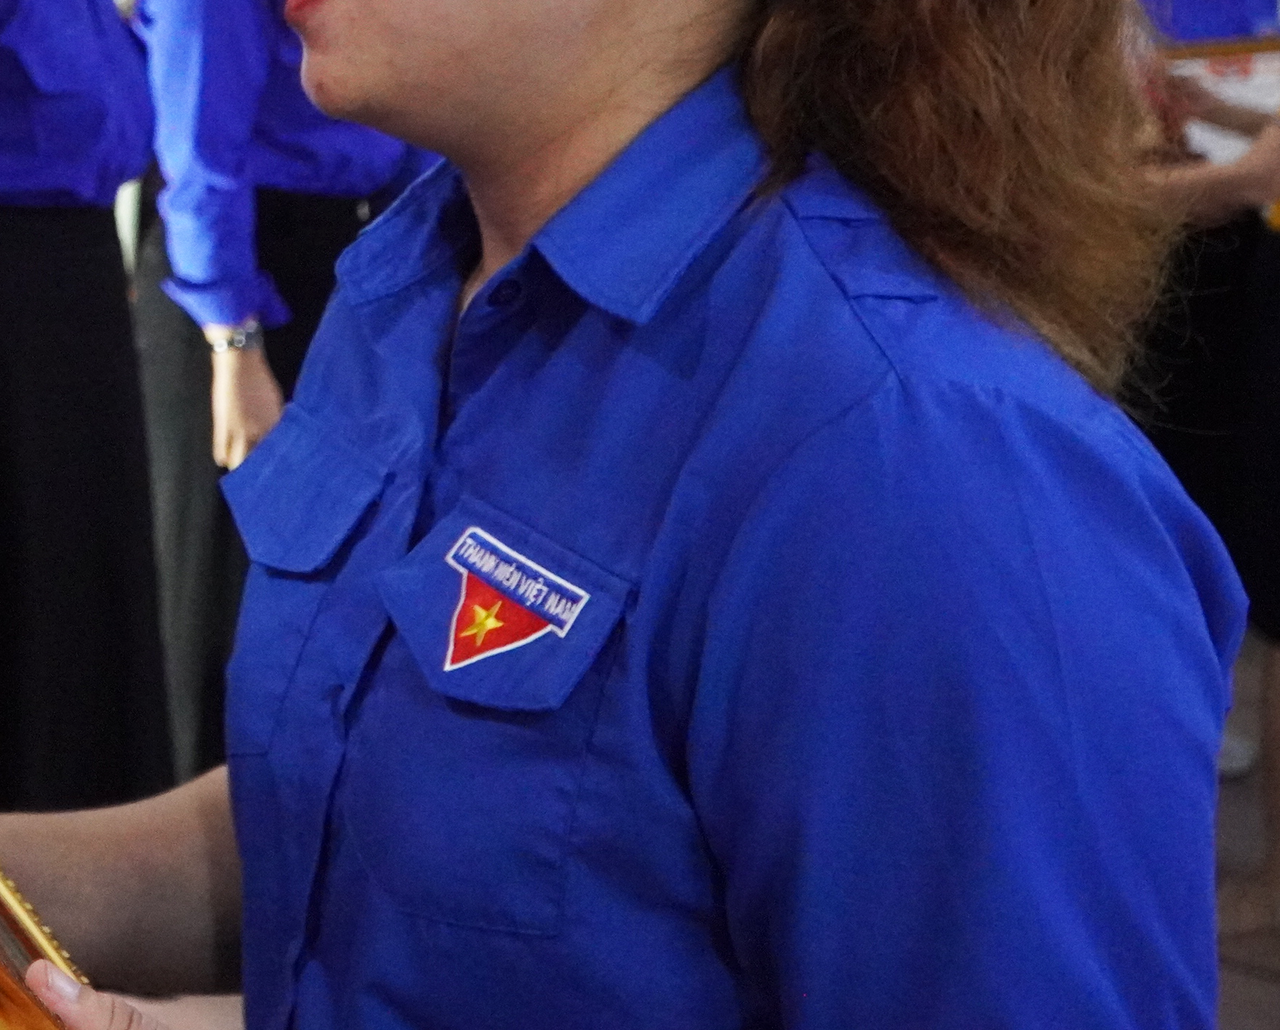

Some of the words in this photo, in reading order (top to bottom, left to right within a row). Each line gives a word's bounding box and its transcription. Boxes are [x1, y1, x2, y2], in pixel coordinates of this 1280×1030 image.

[459, 537, 499, 573] THANH
[518, 576, 549, 606] VIỆT
[544, 591, 579, 620] NAM
